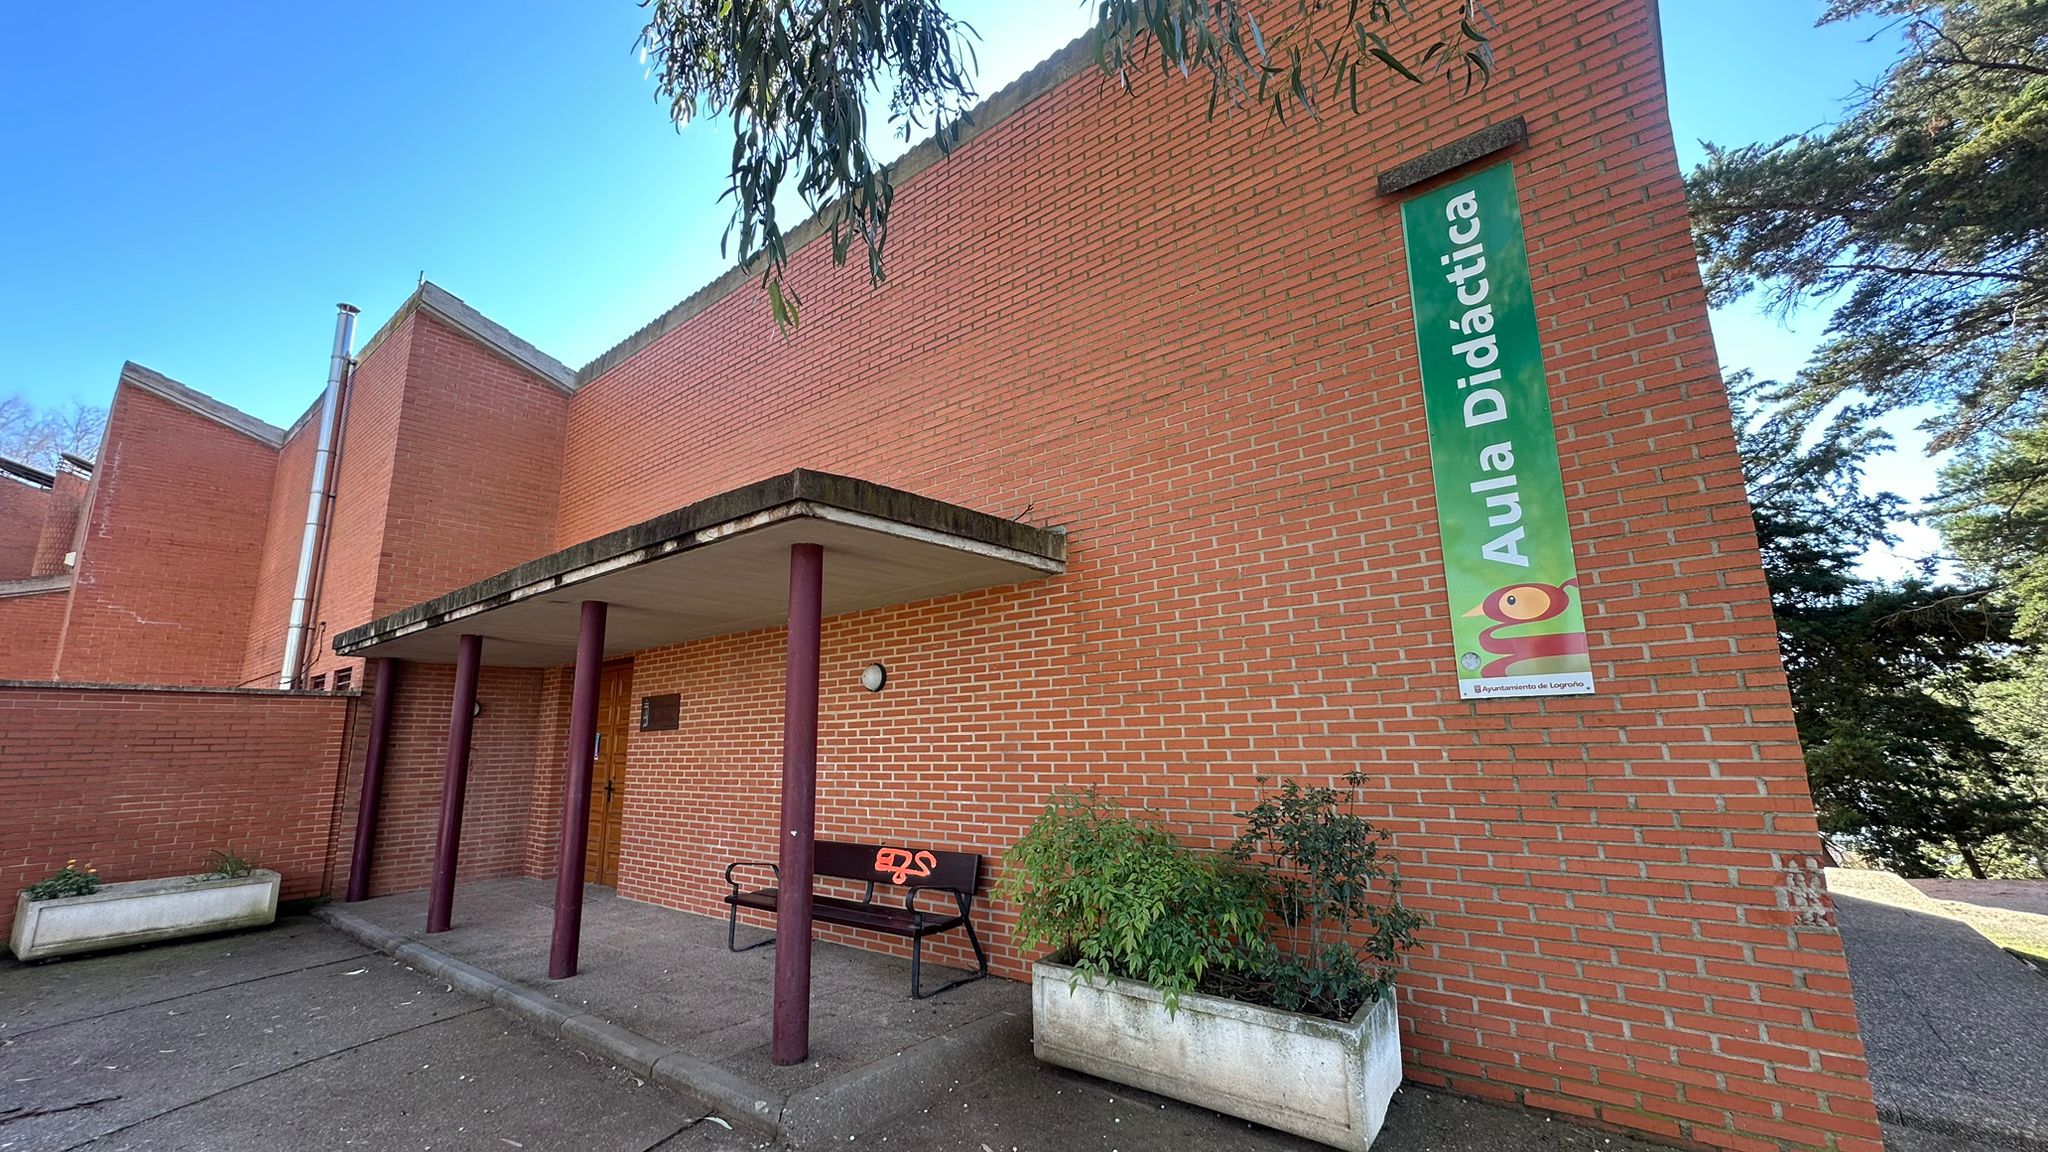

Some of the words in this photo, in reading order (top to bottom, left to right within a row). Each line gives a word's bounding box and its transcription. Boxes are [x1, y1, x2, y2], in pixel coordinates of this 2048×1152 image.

[1441, 190, 1508, 428] Didáctica
[1470, 441, 1529, 568] Aula
[1482, 684, 1536, 694] Ayuntamiento
[1537, 682, 1548, 690] de
[1550, 681, 1584, 690] Logroño
